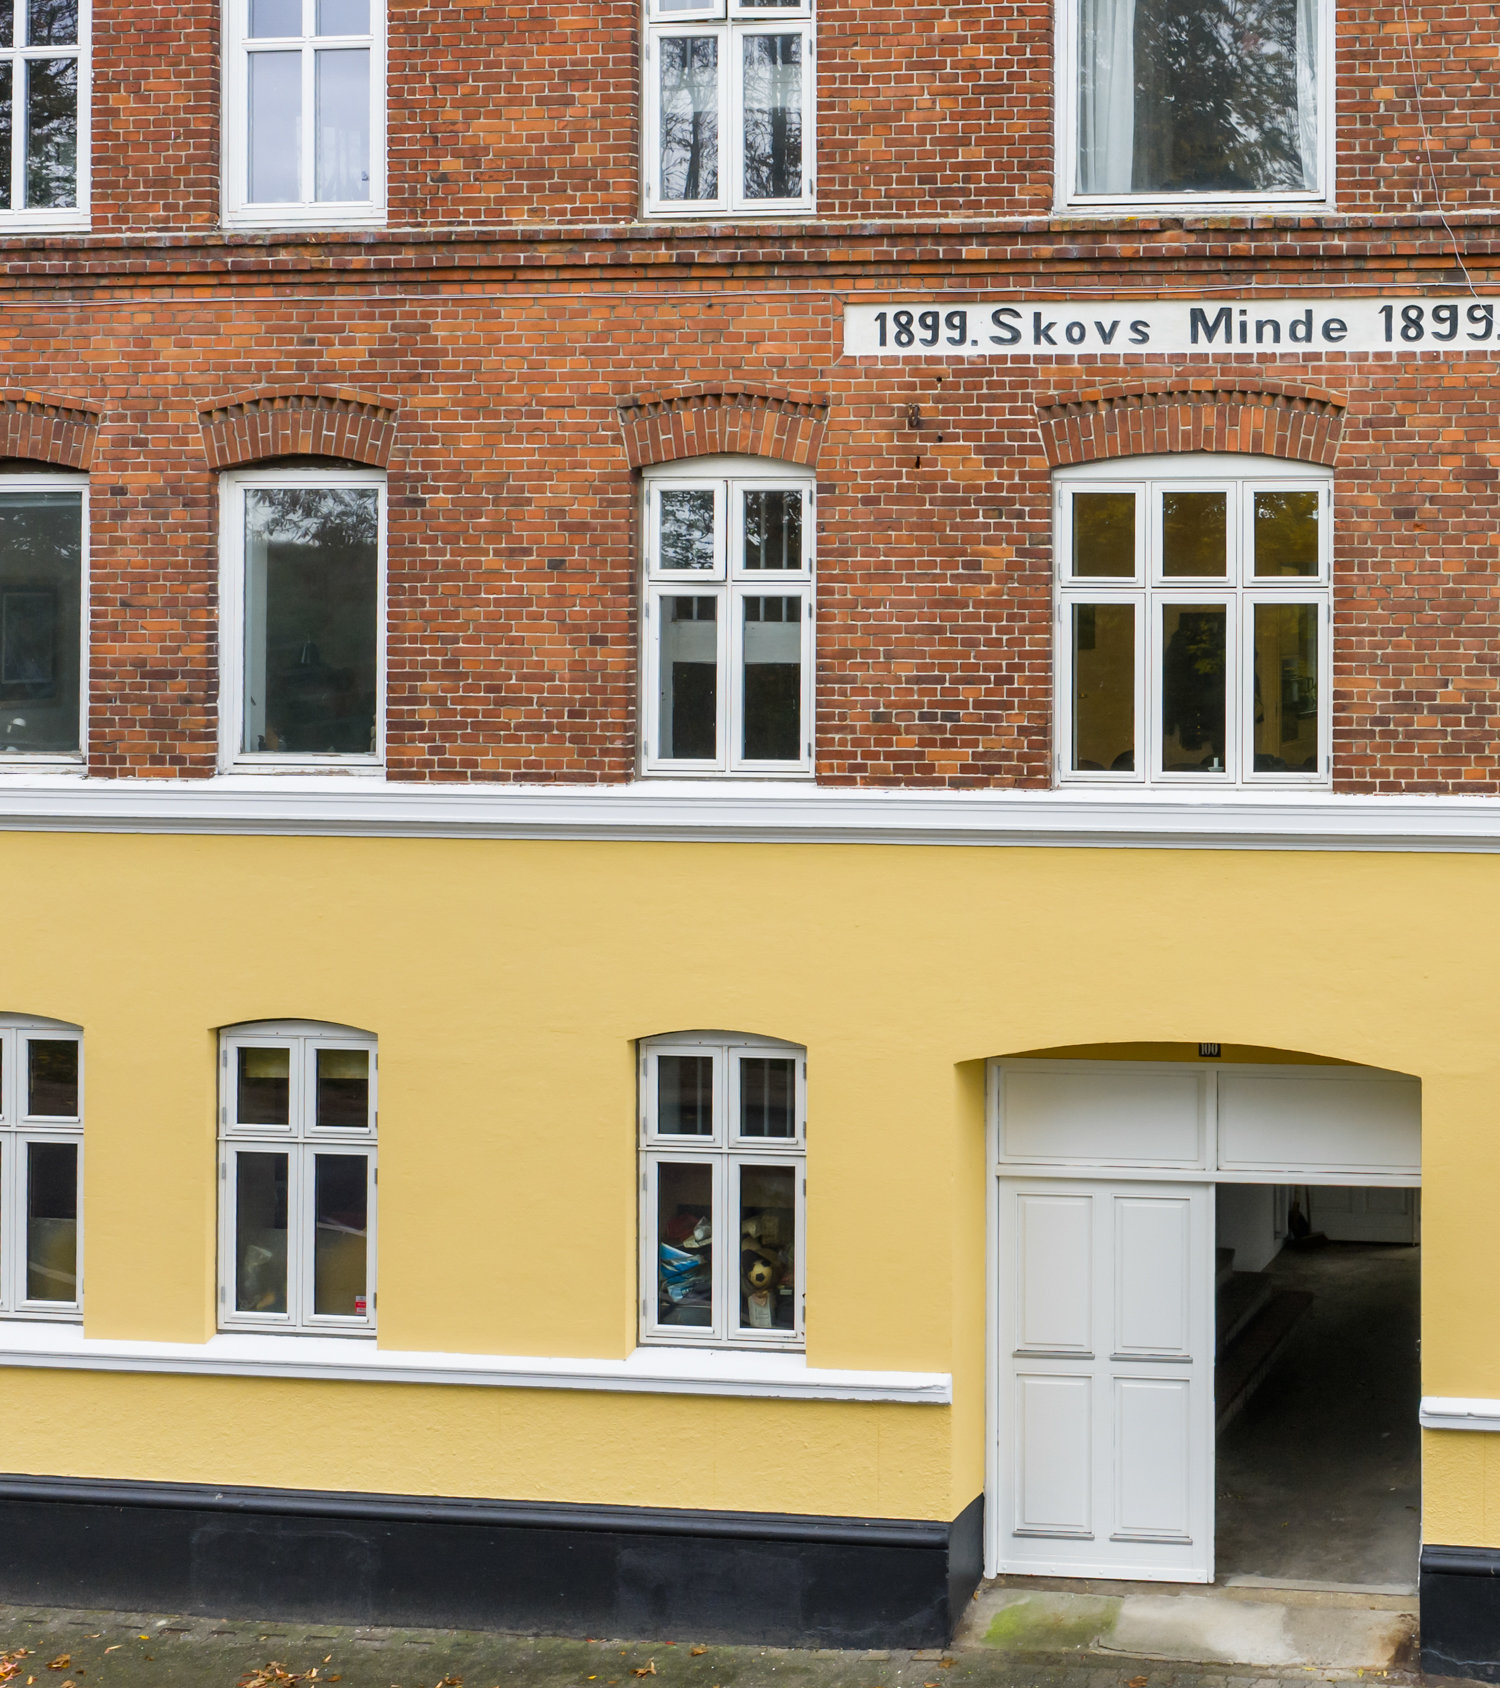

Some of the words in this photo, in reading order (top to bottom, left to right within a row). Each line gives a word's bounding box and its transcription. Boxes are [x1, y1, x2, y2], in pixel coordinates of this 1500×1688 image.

[874, 310, 978, 347] 1899.
[989, 307, 1151, 346] Skovs
[1189, 307, 1348, 345] Minde
[1201, 1042, 1218, 1056] 100
